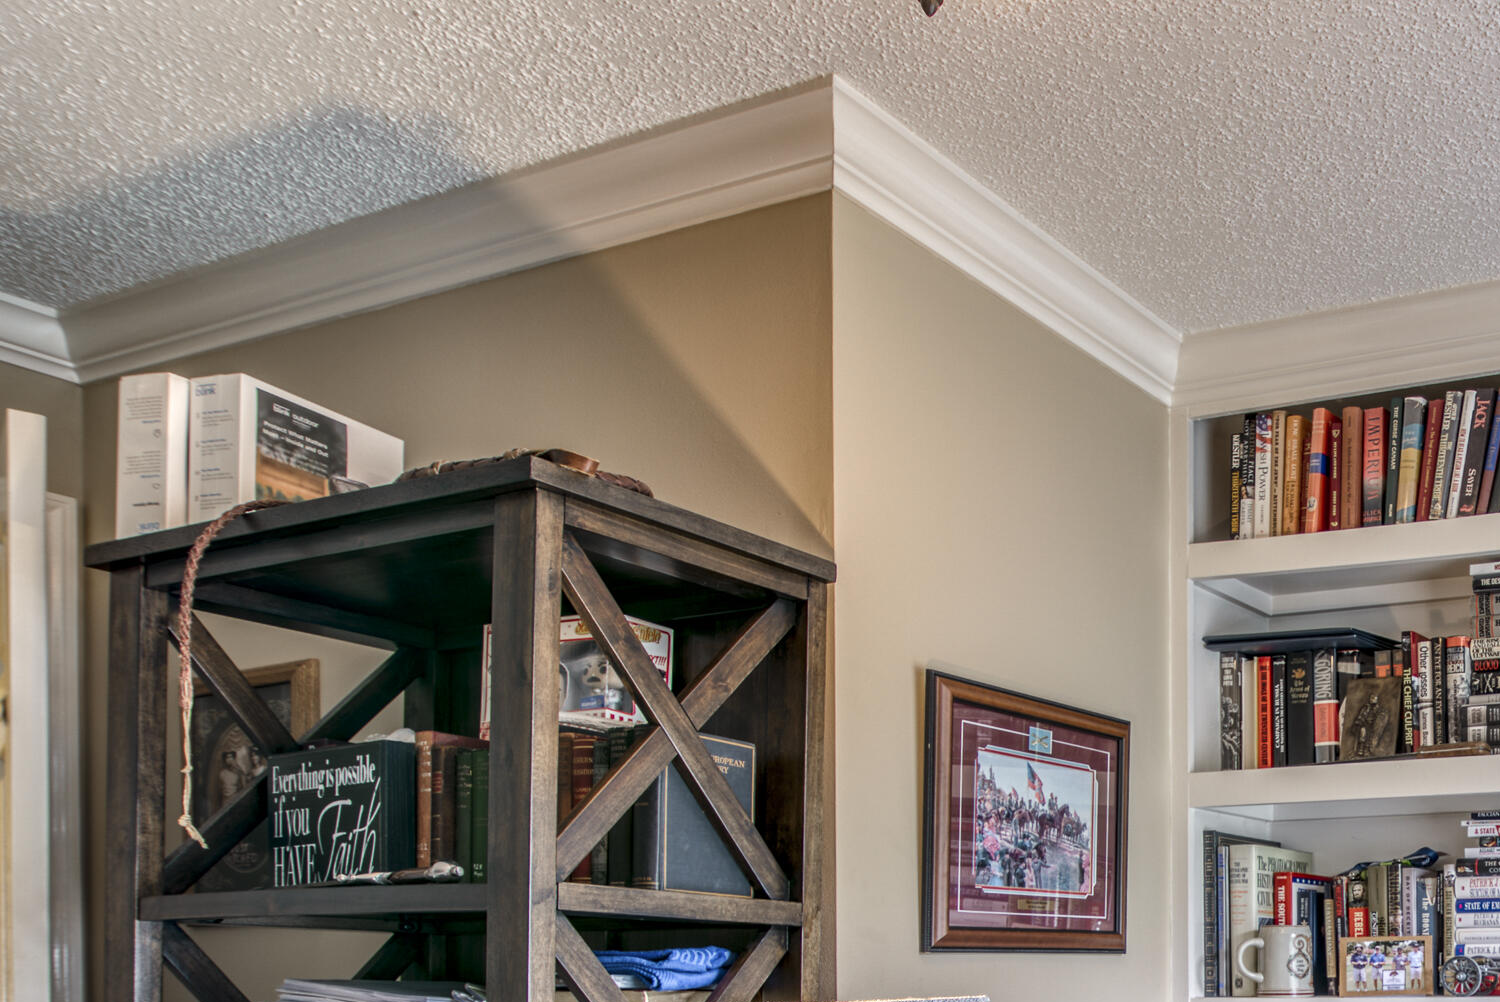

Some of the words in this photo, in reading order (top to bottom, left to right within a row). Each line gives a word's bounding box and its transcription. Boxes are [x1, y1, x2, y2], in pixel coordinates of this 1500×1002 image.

[1474, 397, 1490, 429] JACK
[1367, 417, 1380, 500] IMPERIUM
[1403, 668, 1411, 684] THE
[1475, 659, 1499, 671] BLOOD
[1403, 685, 1412, 710] CHIEF
[1404, 712, 1413, 746] CULPRIT
[272, 762, 325, 798] Everything
[335, 754, 376, 796] possible
[274, 795, 285, 838] if
[286, 807, 311, 847] you
[274, 844, 322, 887] HAVE
[317, 777, 381, 883] Faith
[1354, 912, 1364, 937] REBEL
